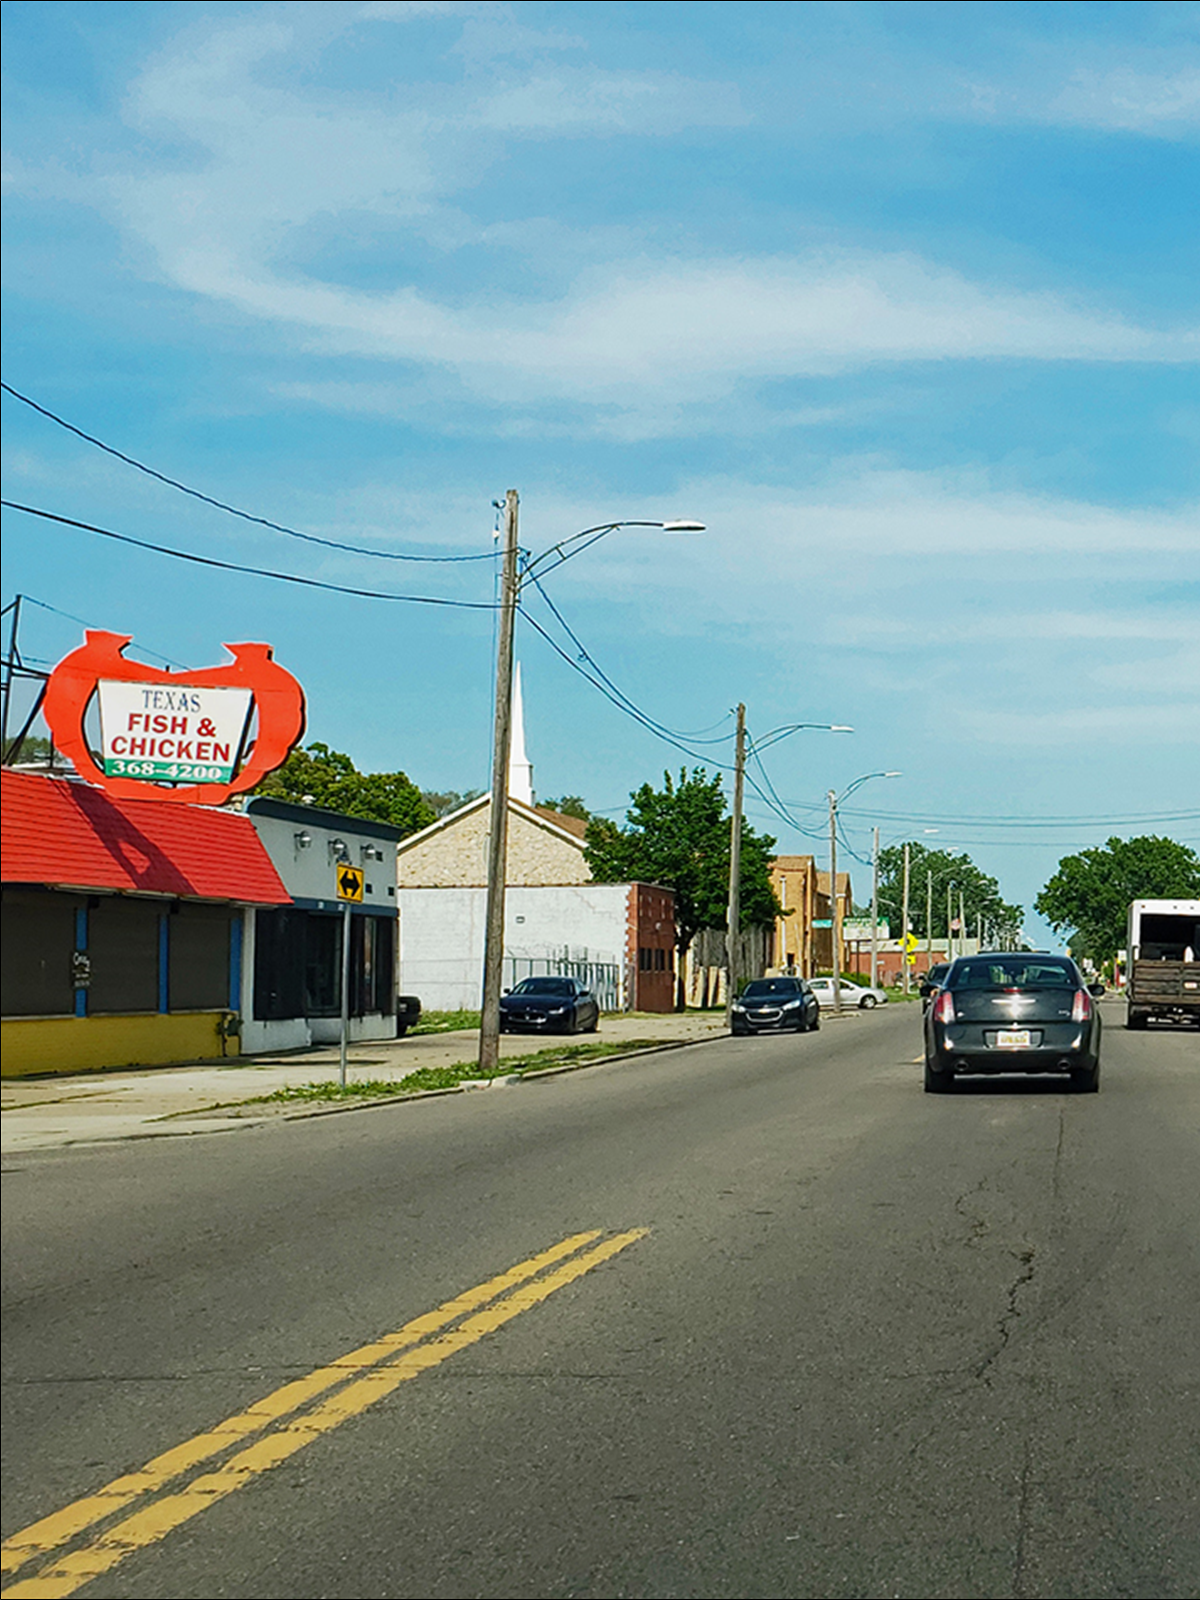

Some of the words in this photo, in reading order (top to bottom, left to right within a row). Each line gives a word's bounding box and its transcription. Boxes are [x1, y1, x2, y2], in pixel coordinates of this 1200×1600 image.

[142, 689, 202, 713] TEXAS
[128, 713, 188, 735] FISH
[197, 717, 217, 738] &
[111, 736, 230, 762] CHICKEN
[112, 760, 222, 780] 368-4200
